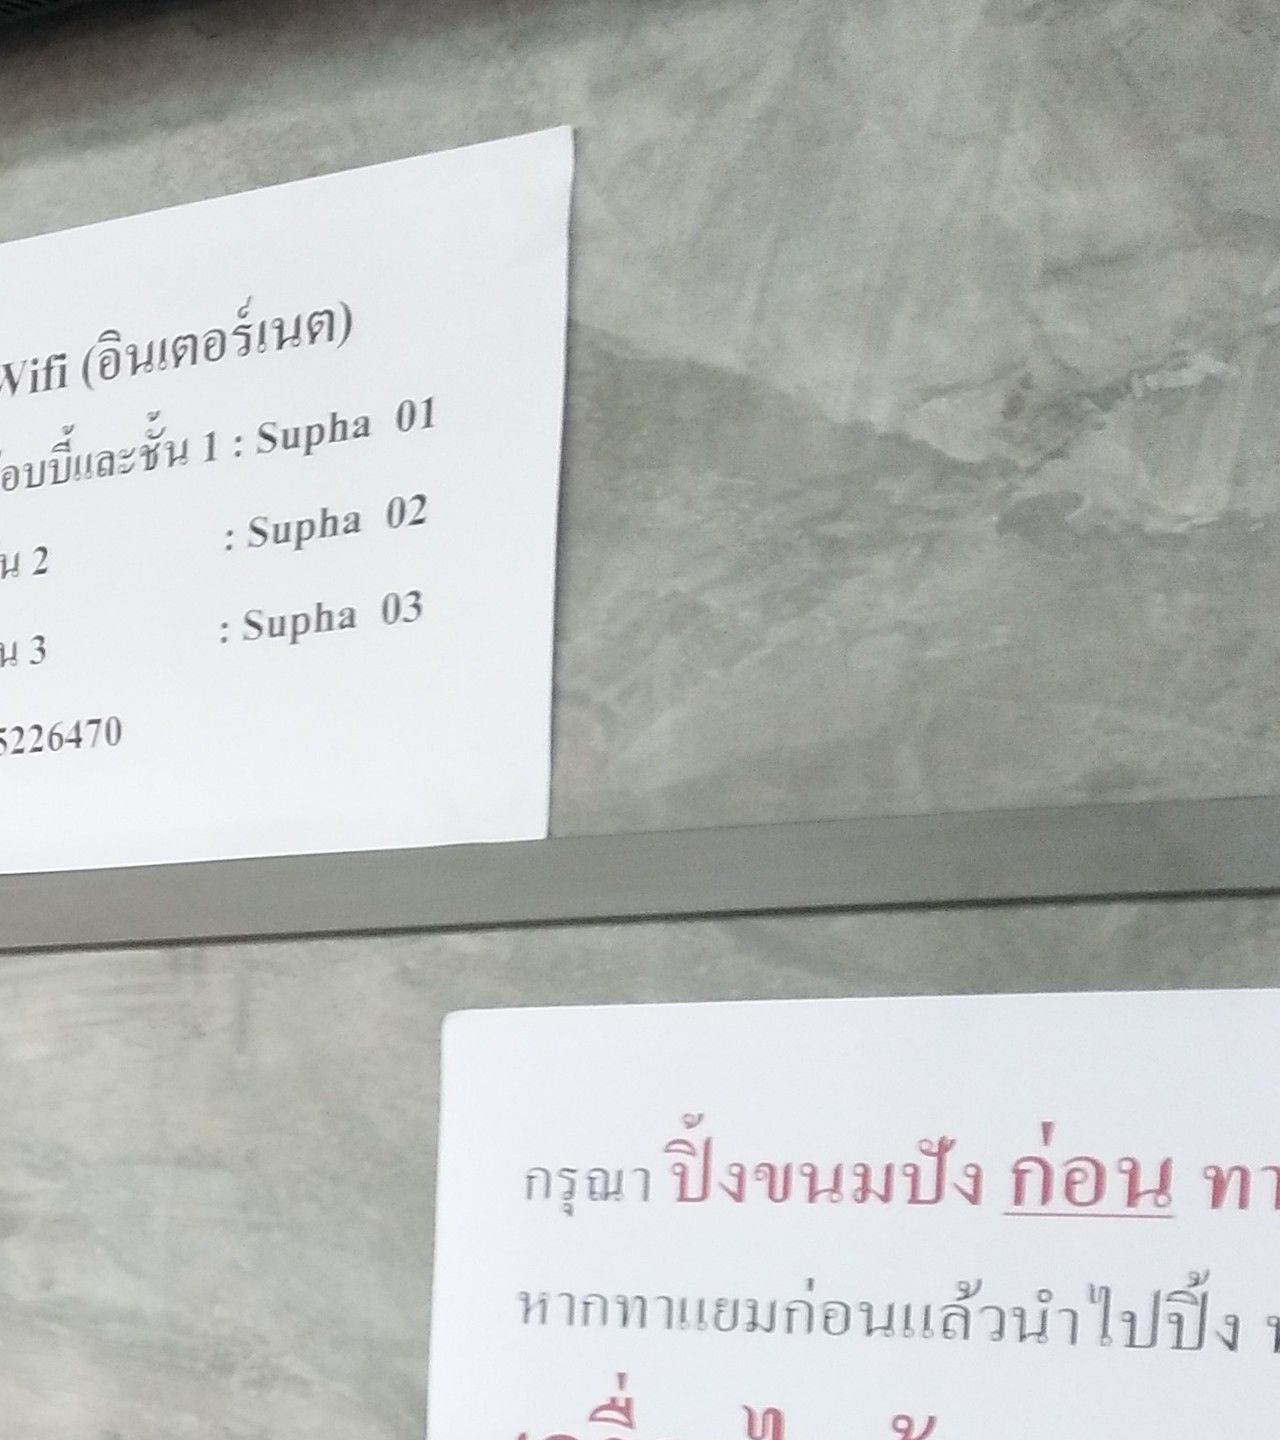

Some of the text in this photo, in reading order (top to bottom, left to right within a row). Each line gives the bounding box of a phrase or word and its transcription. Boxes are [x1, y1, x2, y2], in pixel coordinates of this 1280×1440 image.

[203, 430, 218, 463] 1
[256, 411, 372, 457] Supha
[395, 396, 436, 433] 01
[31, 545, 50, 576] 2
[247, 507, 362, 552] Supha
[386, 493, 428, 529] 02
[29, 634, 48, 666] 3
[242, 601, 357, 646] Supha
[381, 589, 423, 626] 03
[525, 1166, 652, 1217] กรุณา
[663, 1112, 985, 1206] ปิ้งขนมปัง
[1010, 1120, 1174, 1209] ก่อน
